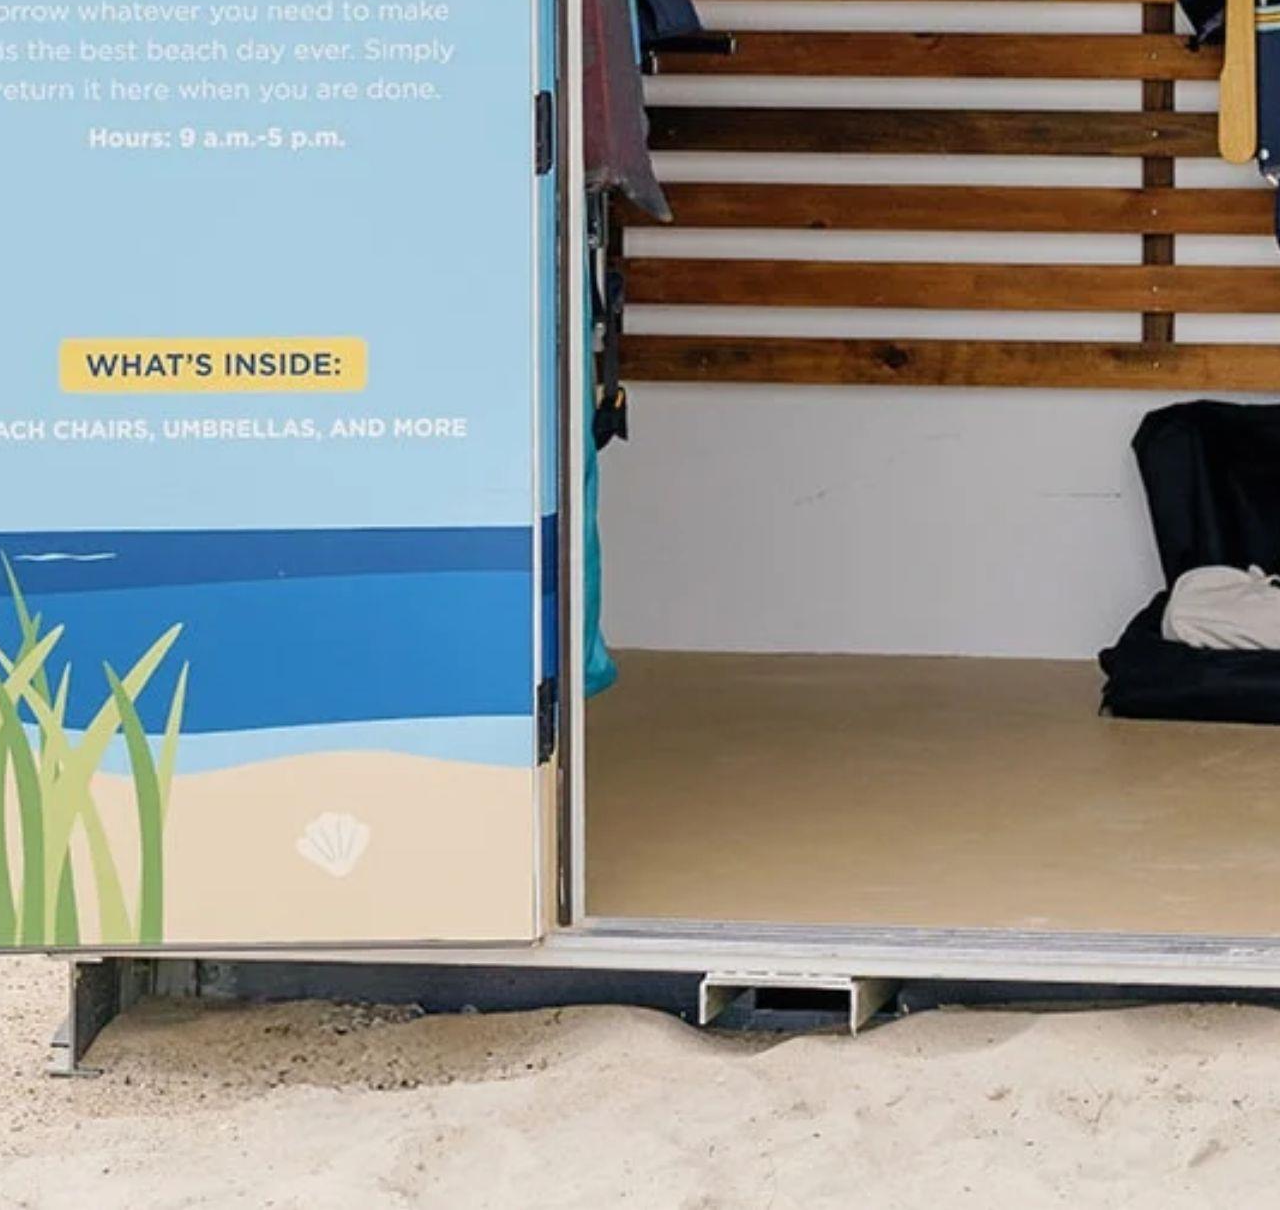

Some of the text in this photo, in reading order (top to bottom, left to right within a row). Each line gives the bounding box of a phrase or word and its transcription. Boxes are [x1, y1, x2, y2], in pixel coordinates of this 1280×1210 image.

[78, 0, 201, 21] whatever
[210, 5, 257, 25] you
[268, 0, 333, 21] need
[342, 1, 369, 22] to
[379, 0, 448, 21] make
[28, 39, 71, 61] the
[80, 39, 138, 61] best
[147, 39, 227, 62] beach
[237, 39, 285, 64] day
[294, 44, 355, 61] ever.
[365, 39, 454, 64] Simply
[85, 79, 100, 100] it
[111, 80, 169, 100] here
[179, 79, 249, 100] when
[260, 82, 307, 103] you
[316, 82, 357, 100] are
[367, 79, 440, 100] done.
[90, 128, 345, 150] Hours: 9 a.m.-5 p.m.
[86, 353, 340, 377] WHAT'S INSIDE:
[53, 419, 155, 442] CHAIRS,
[163, 419, 321, 440] UMBRELLAS,
[330, 418, 385, 438] AND
[394, 418, 467, 437] MORE
